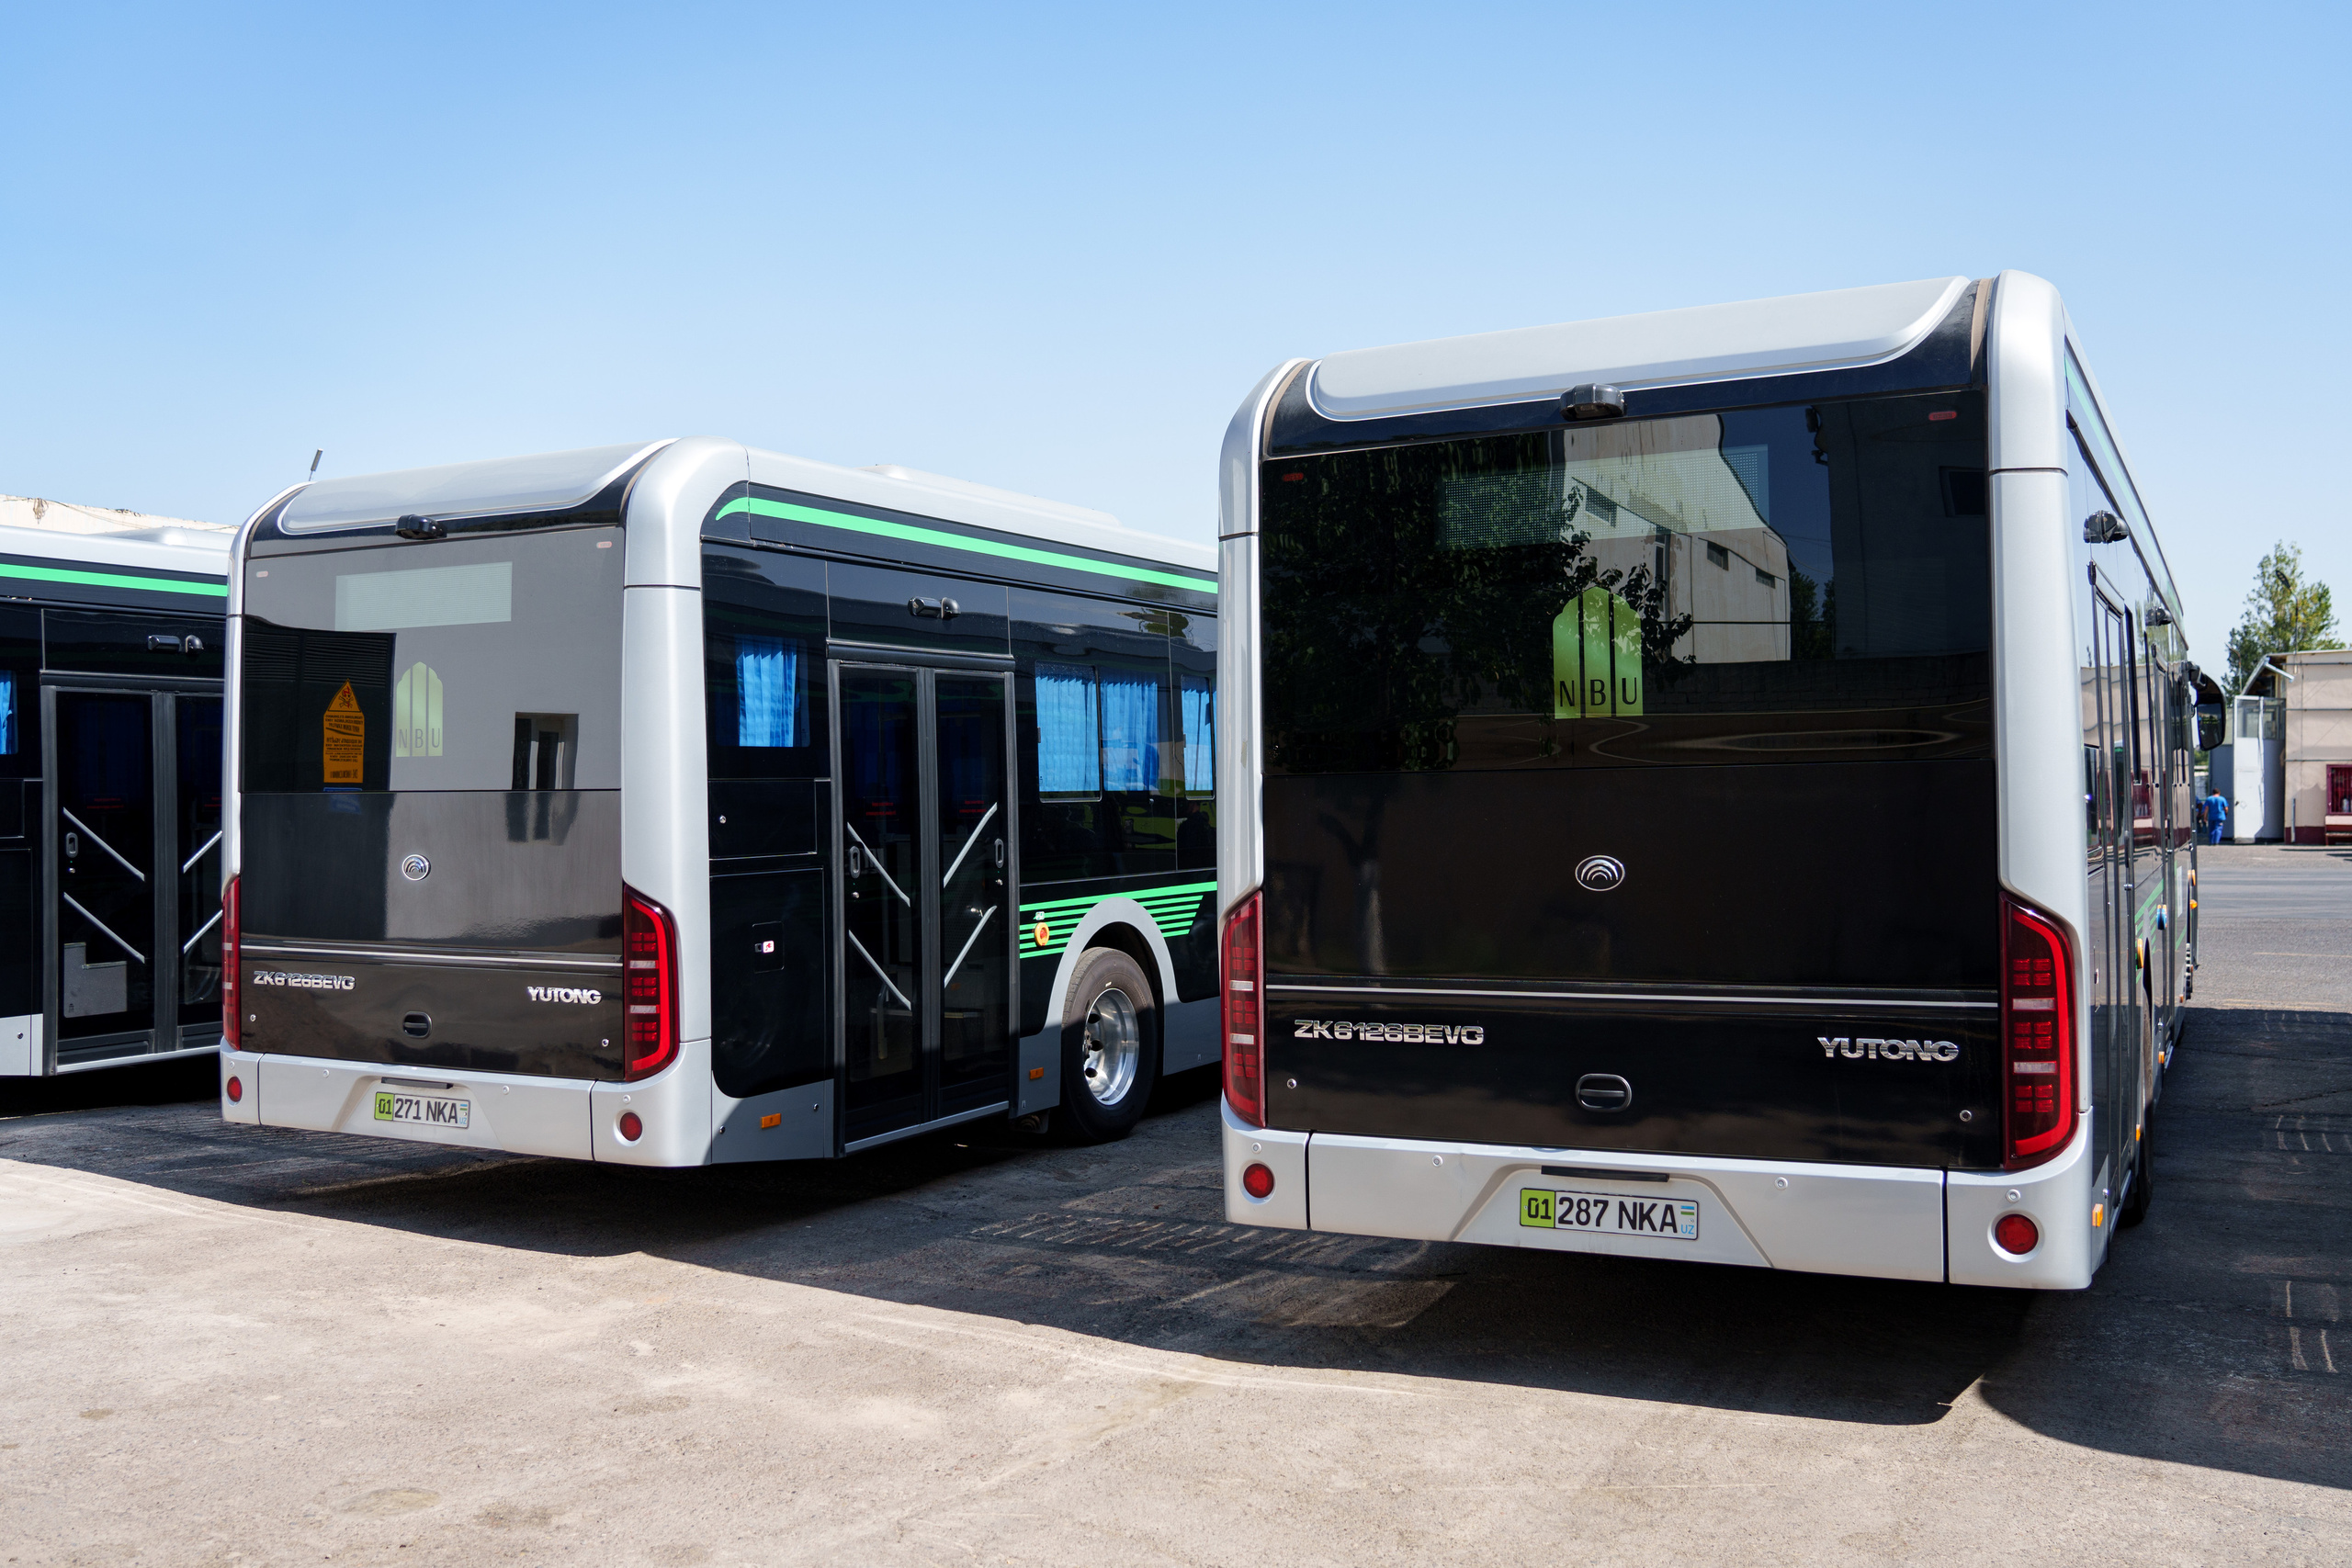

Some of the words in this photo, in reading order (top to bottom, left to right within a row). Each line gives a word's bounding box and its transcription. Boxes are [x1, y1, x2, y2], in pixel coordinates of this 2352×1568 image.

[1559, 677, 1638, 707] NBU
[527, 987, 602, 1005] YUTONG
[1294, 1020, 1485, 1045] ZK6126BEVG
[1817, 1037, 1959, 1062] YUTONG
[379, 1099, 392, 1115] 01
[394, 1098, 422, 1120] 271
[425, 1100, 458, 1123] NKA
[1527, 1197, 1552, 1220] 01
[1557, 1197, 1609, 1226] 287
[1618, 1201, 1678, 1233] NKA
[1680, 1224, 1694, 1235] UZ
